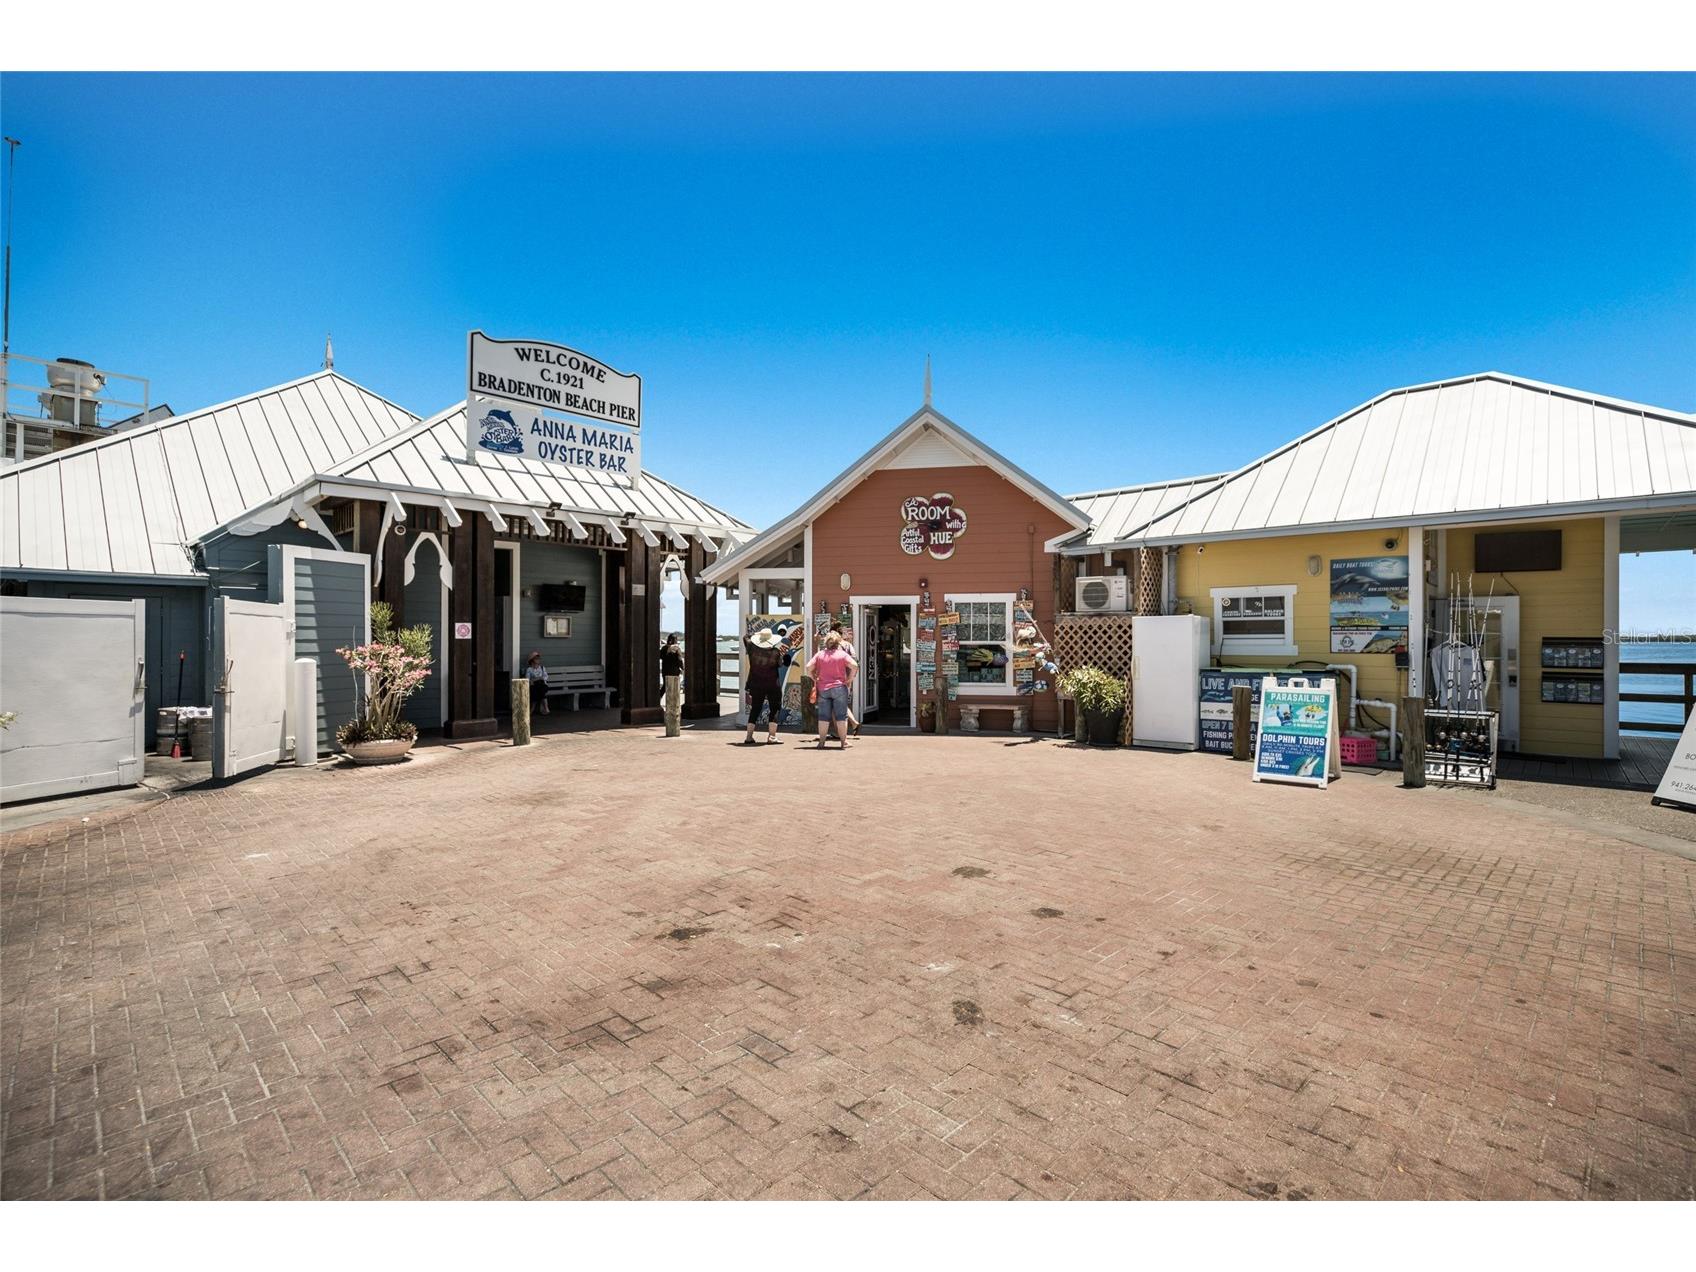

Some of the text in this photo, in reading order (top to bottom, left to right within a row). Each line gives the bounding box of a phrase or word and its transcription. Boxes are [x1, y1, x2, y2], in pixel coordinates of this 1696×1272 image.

[514, 347, 607, 383] WELCOME
[540, 368, 584, 390] C.1921
[478, 372, 636, 422] BRADENTON BEACH PIER
[530, 418, 576, 442] ANNA
[582, 428, 634, 454] MARIA
[538, 441, 628, 473] OYSTER BAR
[907, 506, 950, 520] ROOM
[946, 519, 961, 528] with
[902, 535, 924, 544] Coastal
[930, 532, 952, 544] HUE
[1202, 678, 1224, 690] LIVE
[1270, 692, 1325, 703] PARASAILING
[1202, 720, 1220, 729] OPEN
[1222, 722, 1227, 730] 7
[1203, 730, 1227, 739] FISHING
[1262, 734, 1296, 744] DOLPHIN
[1299, 736, 1325, 746] TOURS
[1205, 740, 1218, 748] BAIT
